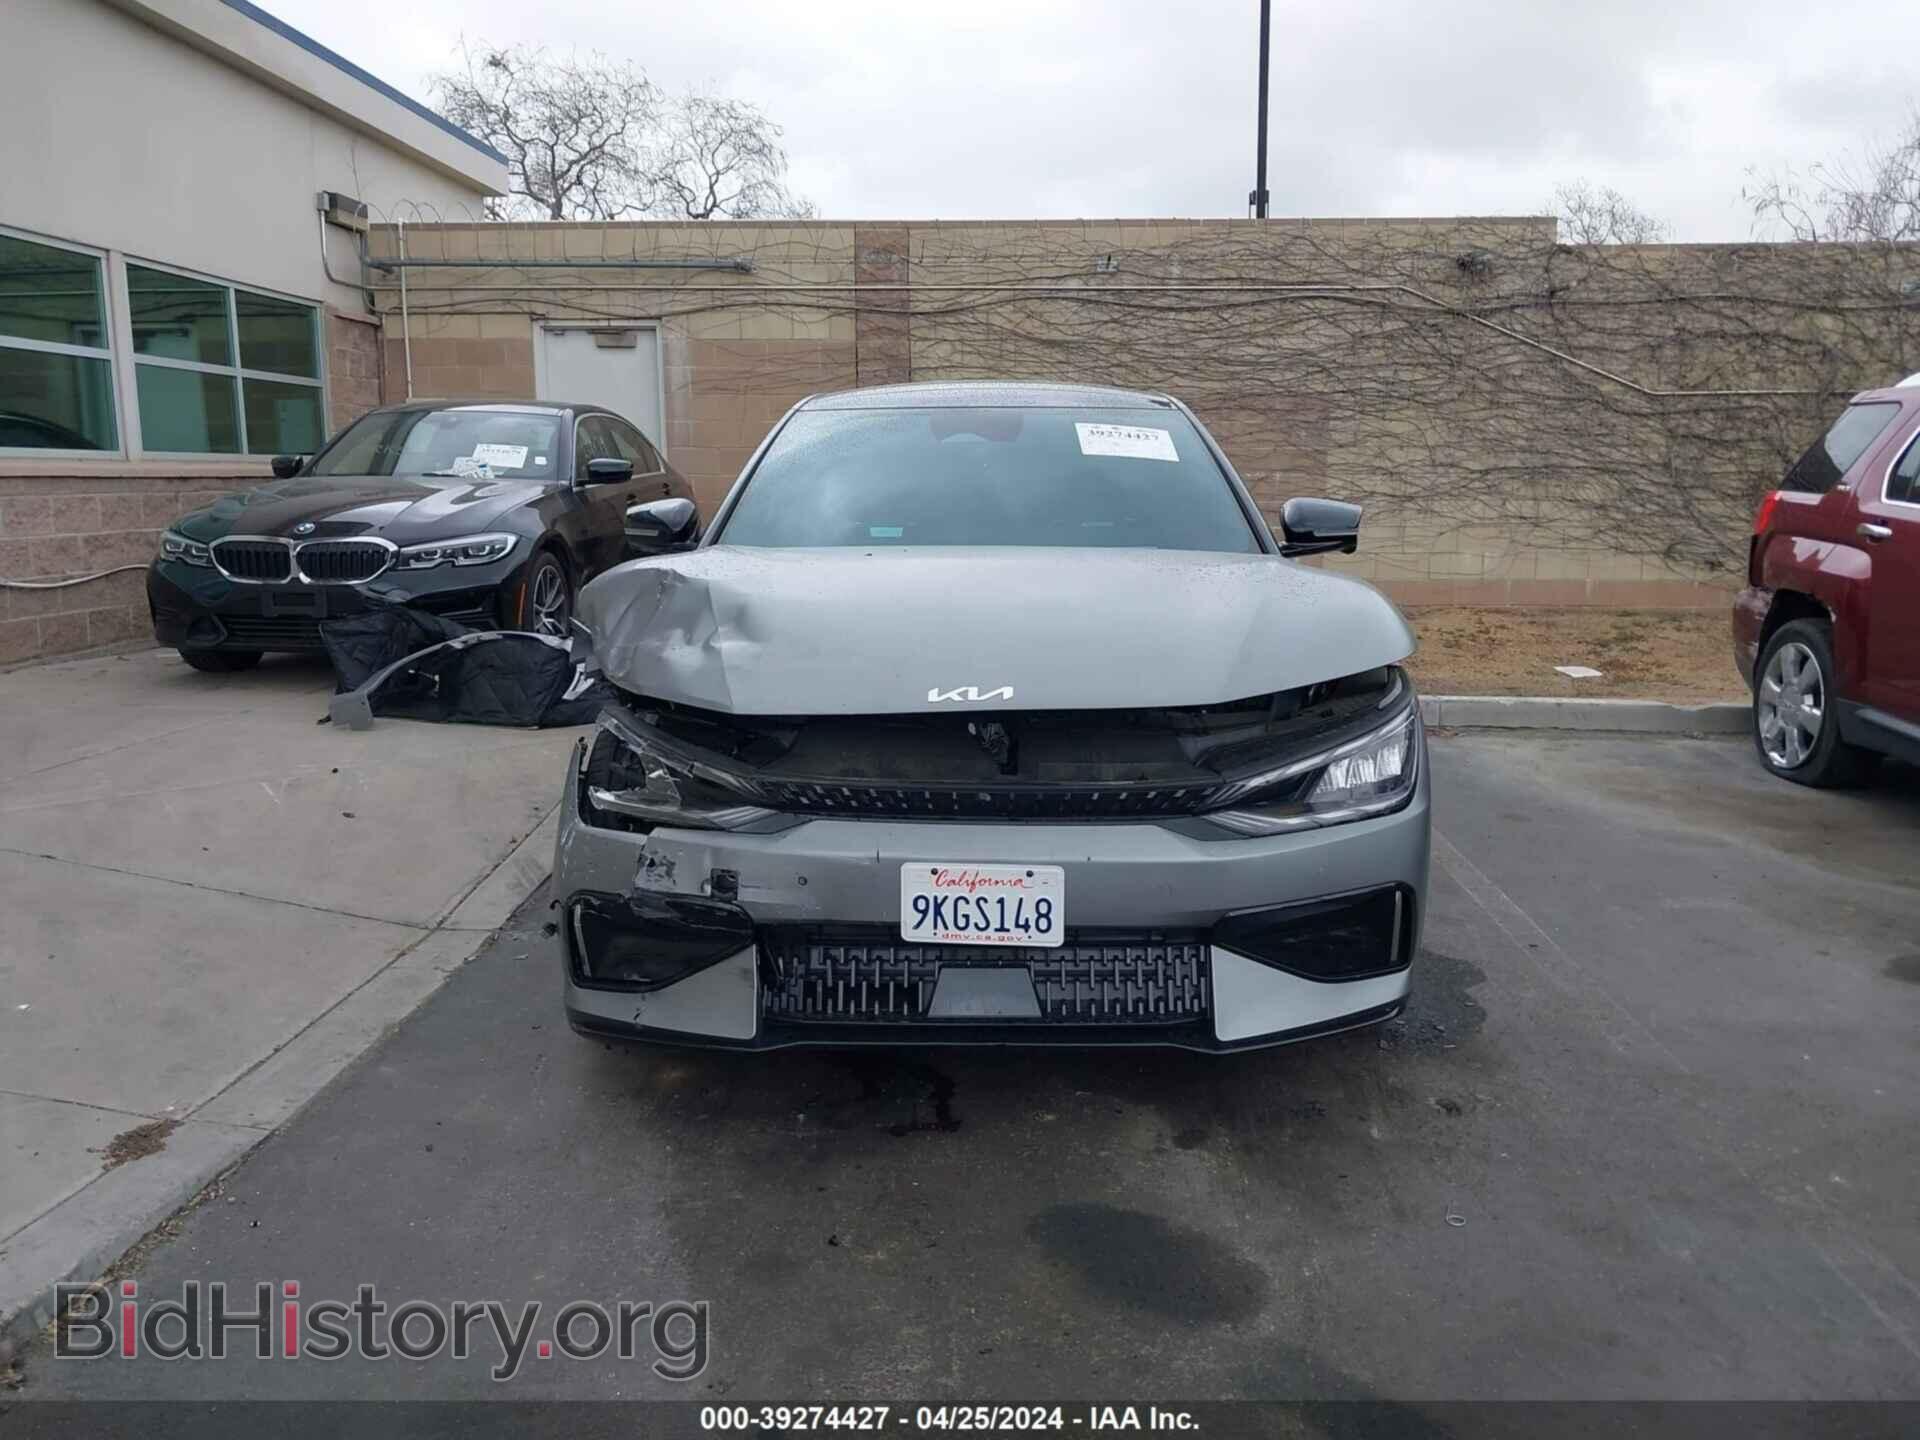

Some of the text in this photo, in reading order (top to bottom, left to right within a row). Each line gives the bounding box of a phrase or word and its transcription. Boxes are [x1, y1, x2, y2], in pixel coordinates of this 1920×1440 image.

[934, 869, 1032, 893] California
[911, 894, 1052, 934] 9KGS148
[941, 931, 1024, 943] dmv.ca.gov
